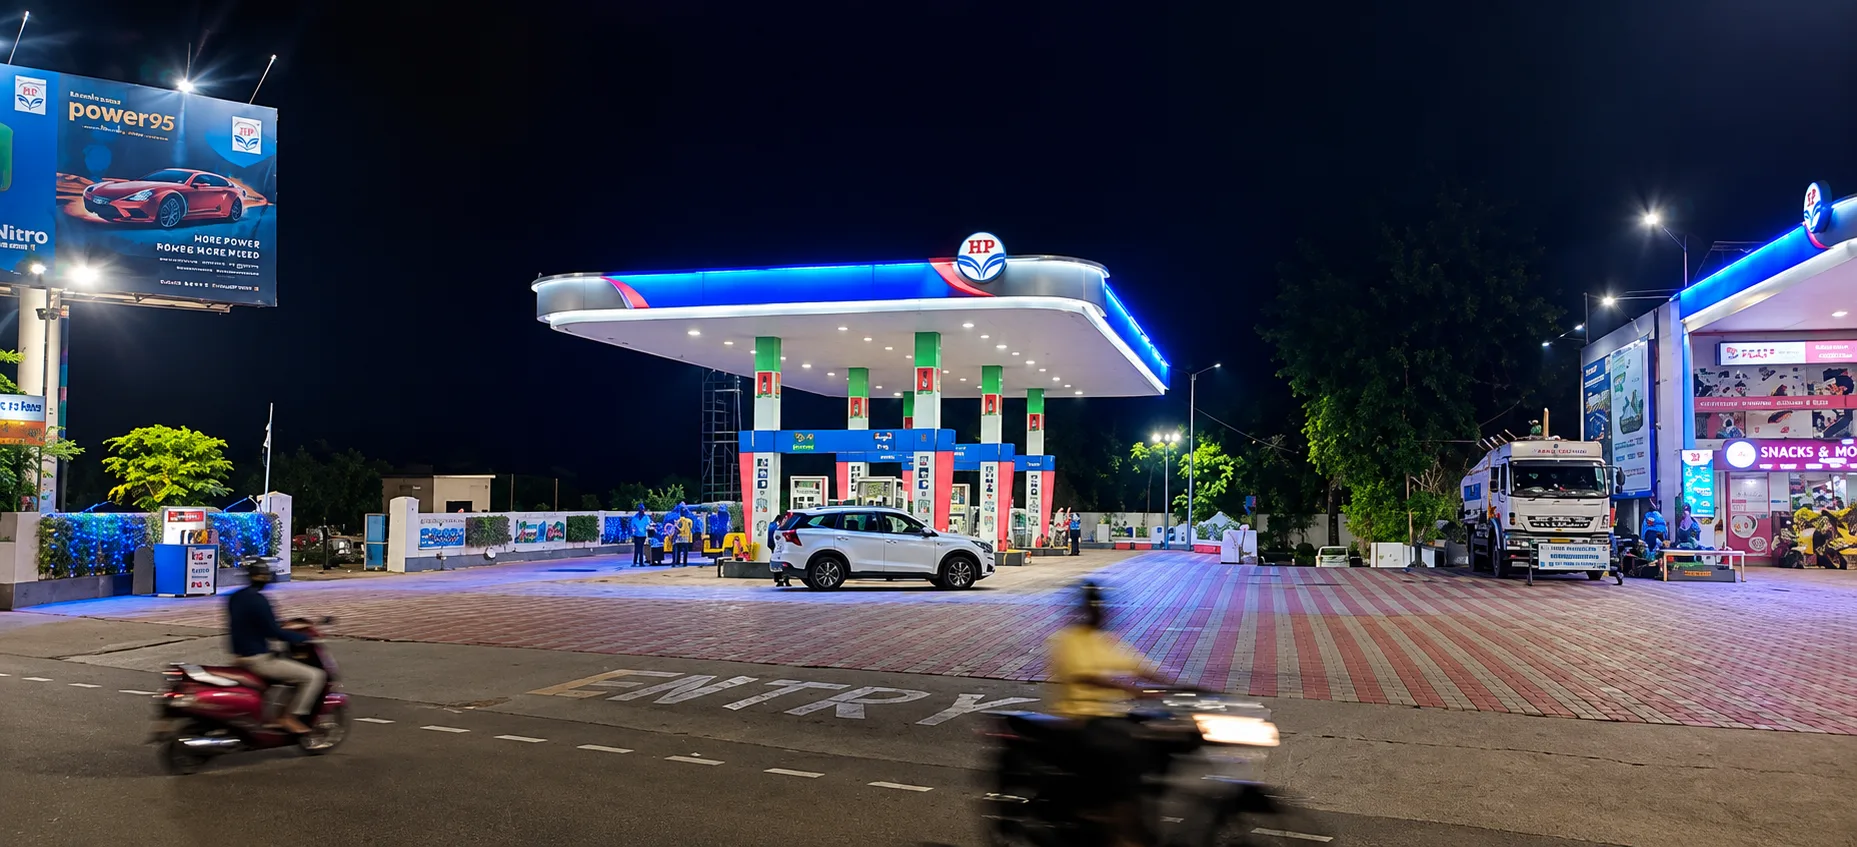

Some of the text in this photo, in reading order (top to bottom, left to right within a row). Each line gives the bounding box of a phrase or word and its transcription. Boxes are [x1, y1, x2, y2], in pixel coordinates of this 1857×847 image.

[69, 101, 175, 131] power95
[0, 224, 48, 245] Nitro
[223, 237, 260, 249] POWER
[968, 239, 995, 254] HP
[1760, 446, 1857, 458] SNACKS & MO
[525, 668, 1041, 726] ENTRY
